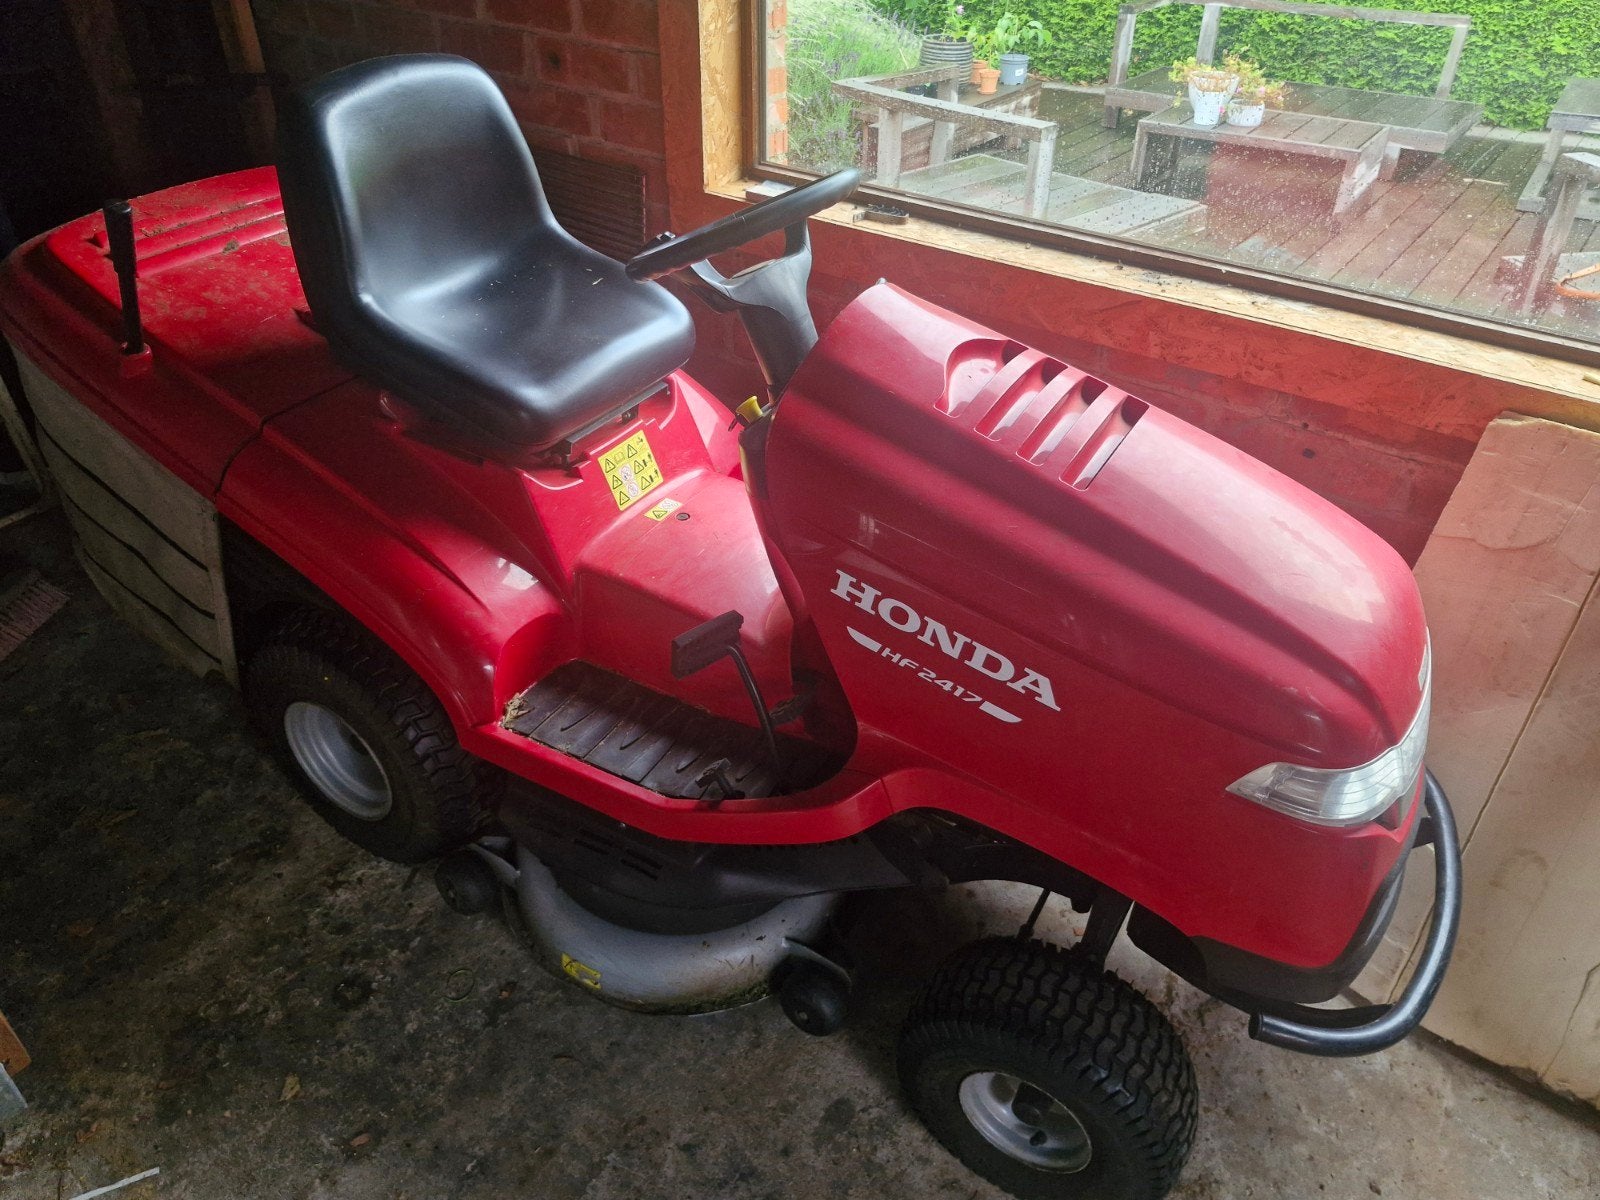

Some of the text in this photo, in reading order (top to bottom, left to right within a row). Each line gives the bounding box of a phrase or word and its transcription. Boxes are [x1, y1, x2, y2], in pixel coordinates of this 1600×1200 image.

[830, 569, 1061, 712] HONDA
[881, 647, 982, 702] HF 2417
